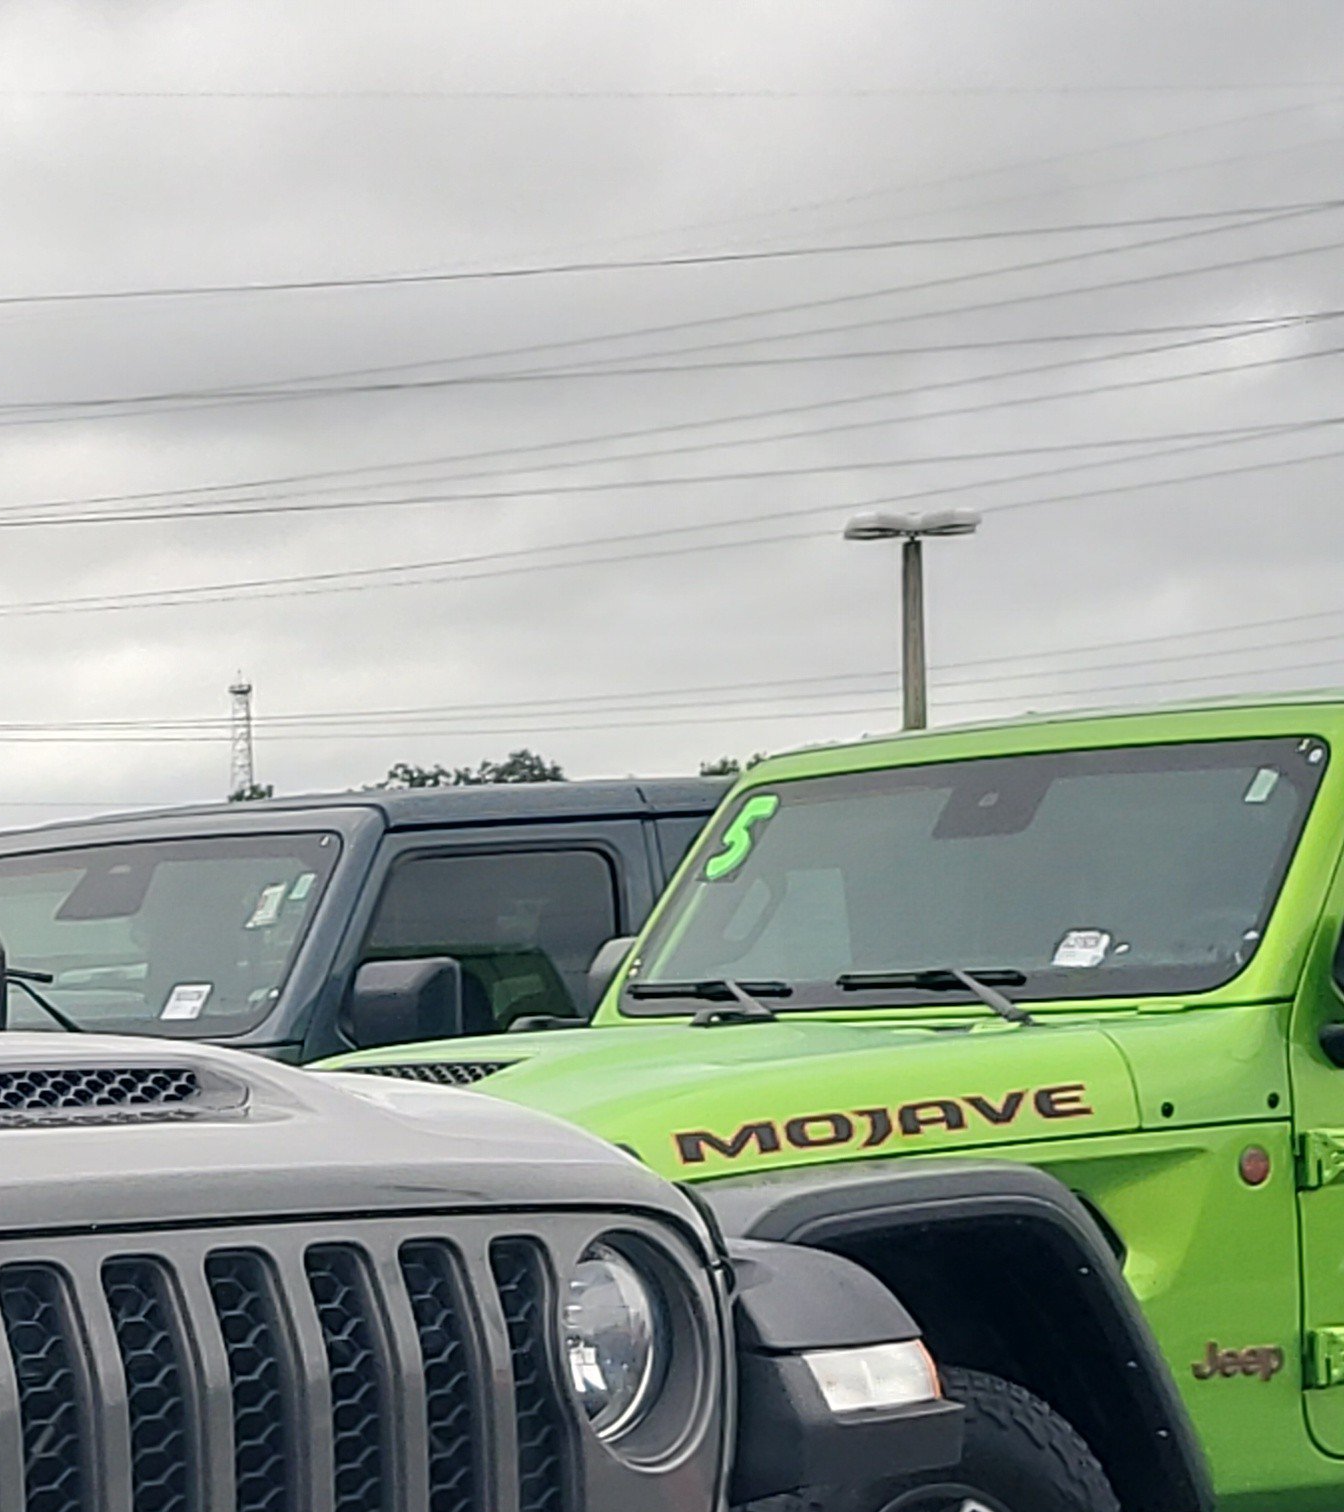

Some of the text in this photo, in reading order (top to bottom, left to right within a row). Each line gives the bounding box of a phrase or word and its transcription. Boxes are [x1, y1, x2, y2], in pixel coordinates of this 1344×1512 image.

[704, 795, 779, 880] 5
[673, 1084, 1094, 1166] MOJAVE
[1191, 1340, 1284, 1382] Jeep
